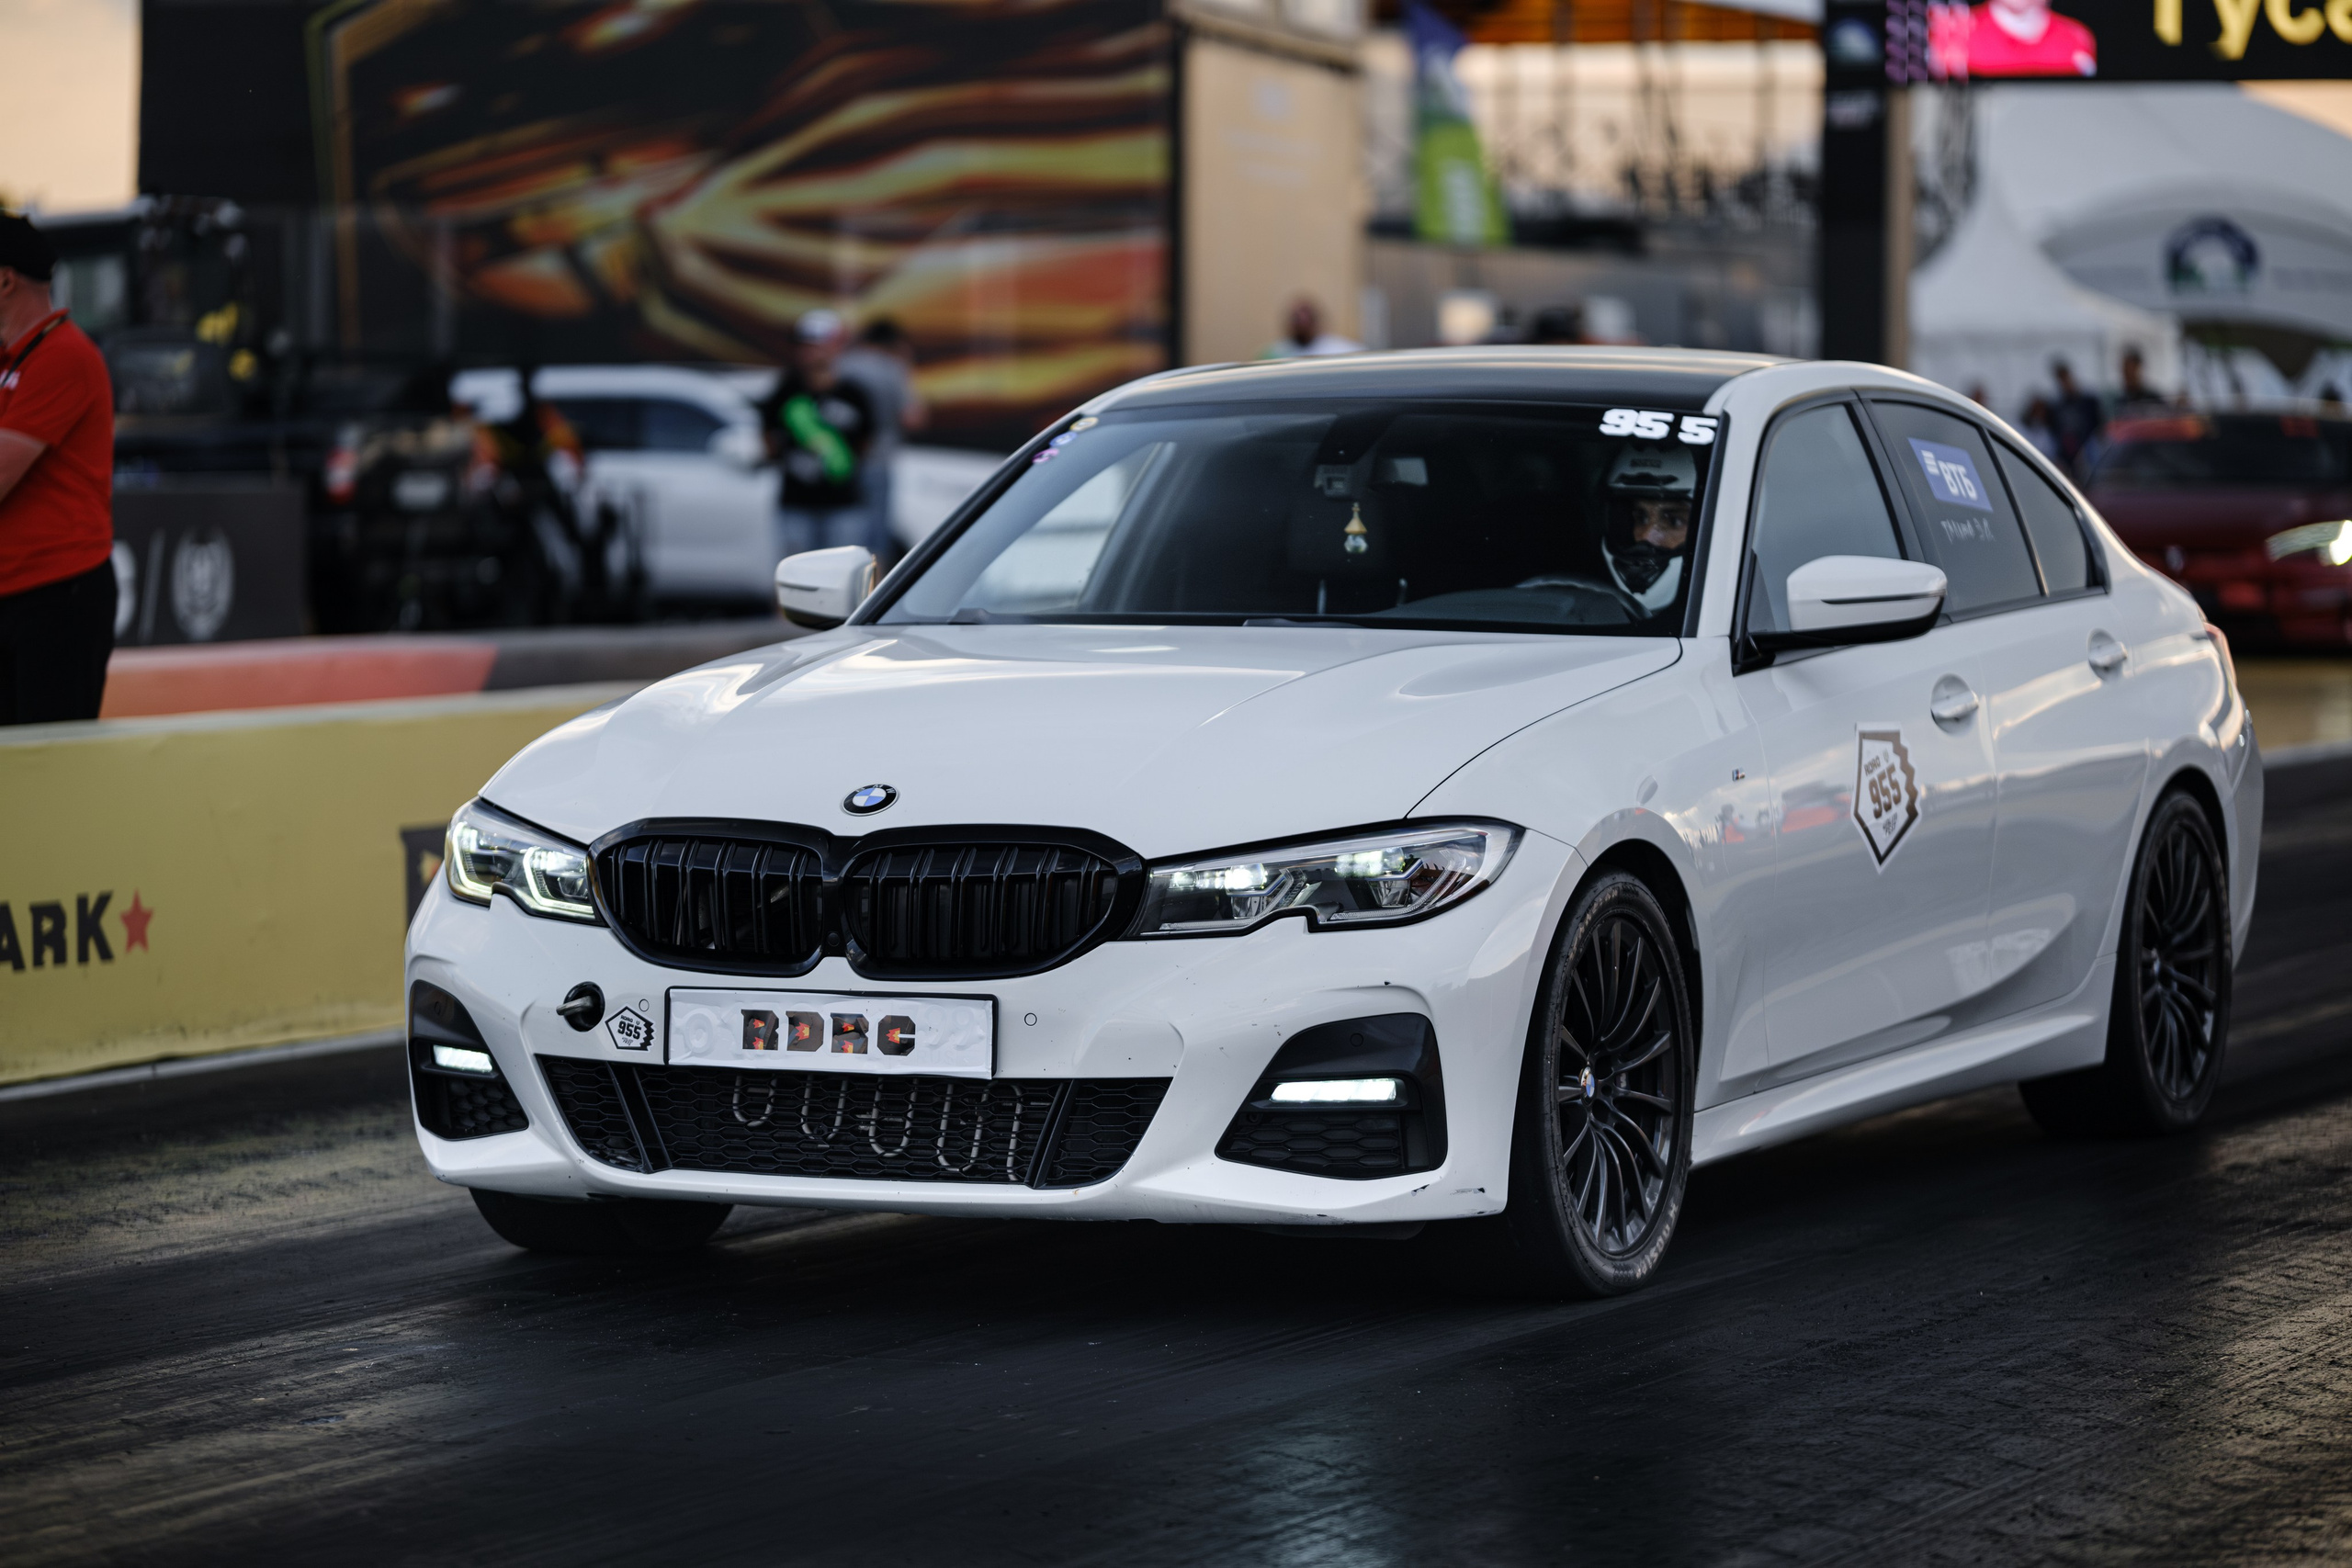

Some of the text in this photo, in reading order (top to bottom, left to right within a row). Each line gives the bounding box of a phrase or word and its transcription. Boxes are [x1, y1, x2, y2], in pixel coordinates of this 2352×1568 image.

[1868, 762, 1902, 819] 955
[617, 1020, 642, 1040] 955
[741, 1009, 916, 1056] RDRC
